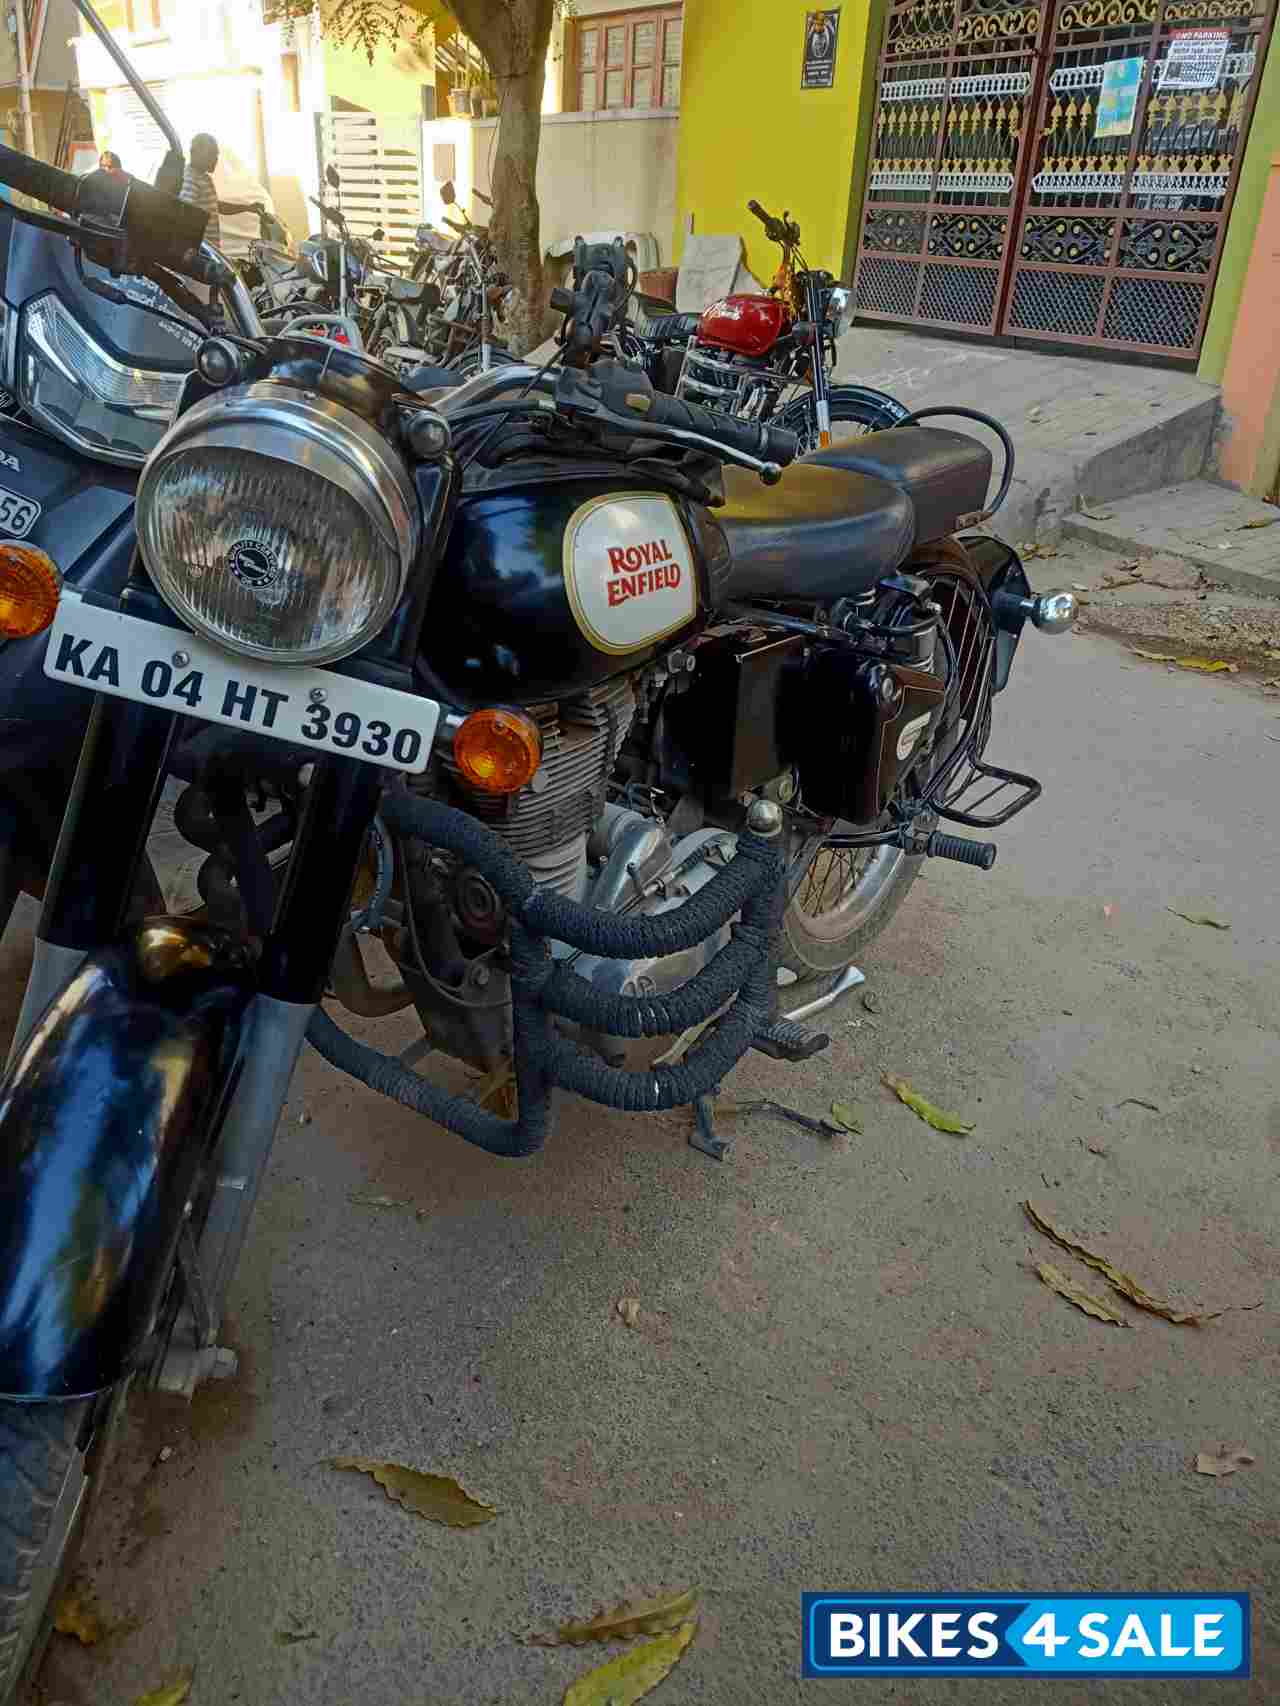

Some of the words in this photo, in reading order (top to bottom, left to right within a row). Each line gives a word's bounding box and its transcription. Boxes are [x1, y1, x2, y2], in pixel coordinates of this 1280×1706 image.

[607, 539, 673, 574] ROYAL
[607, 563, 681, 608] ENFIELD
[55, 633, 120, 687] KA
[140, 659, 204, 707] 04
[221, 680, 289, 728] HT
[301, 702, 422, 764] 3930
